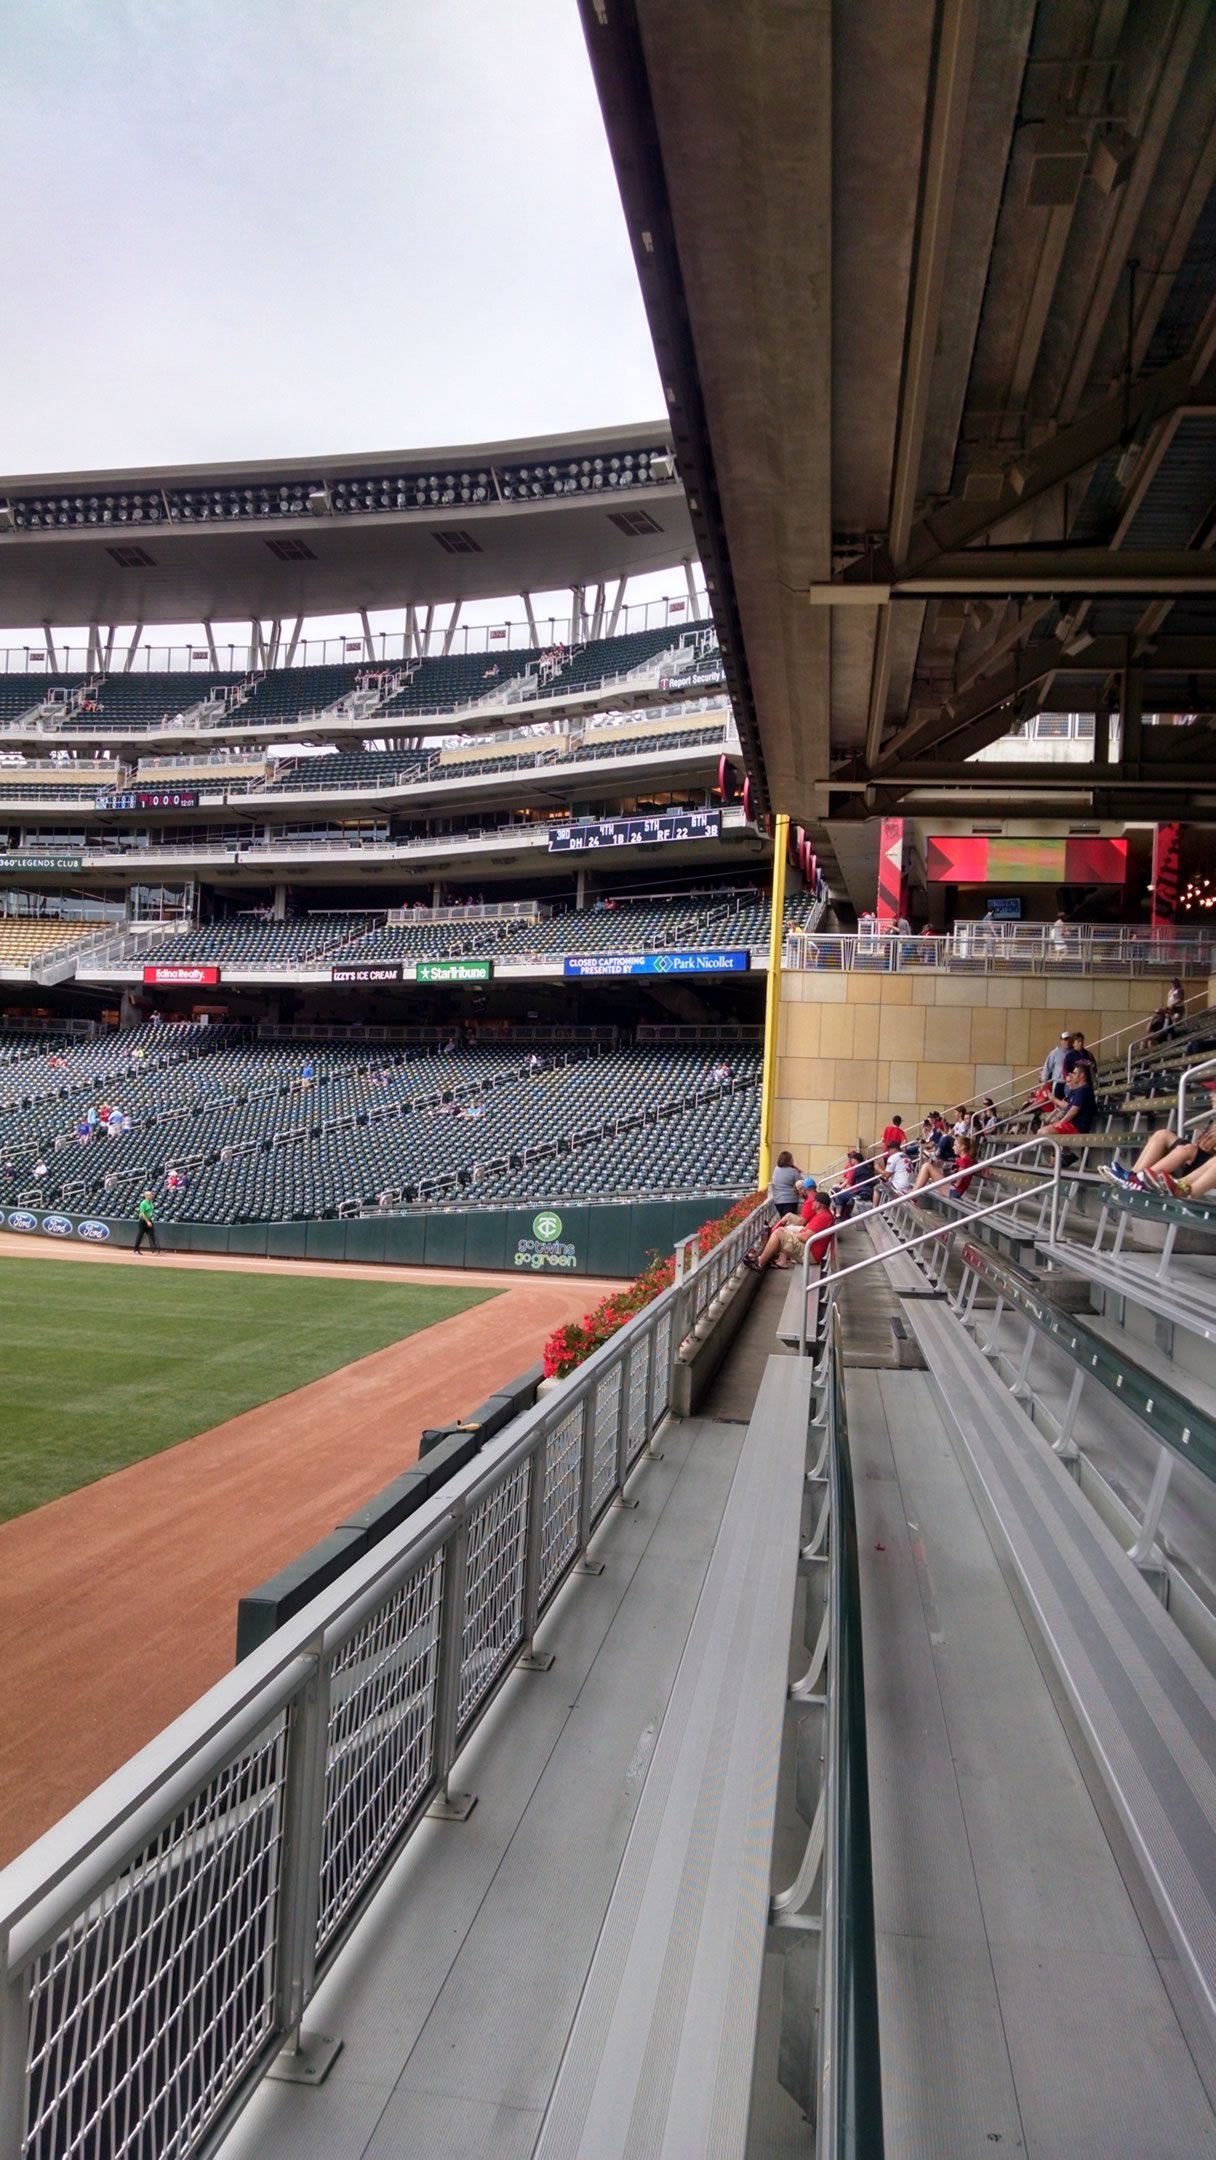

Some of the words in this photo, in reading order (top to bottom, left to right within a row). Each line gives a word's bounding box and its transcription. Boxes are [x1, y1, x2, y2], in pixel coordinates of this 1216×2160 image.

[669, 676, 691, 688] Report
[692, 672, 721, 684] Security
[153, 796, 159, 805] 0
[163, 796, 169, 805] 0
[173, 795, 179, 805] 0
[556, 828, 571, 840] 3RD
[600, 825, 614, 836] 4TH
[644, 820, 660, 831] 5TH
[691, 816, 707, 827] 6TH
[569, 838, 583, 848] DH
[588, 836, 600, 847] 24
[613, 834, 624, 844] 1B
[631, 832, 643, 843] 26
[657, 829, 670, 840] RF
[676, 828, 688, 839] 22
[705, 825, 718, 836] 3B
[569, 958, 598, 967] CLOSED
[598, 956, 645, 966] CAPTIONING
[674, 957, 694, 968] Park
[696, 956, 734, 968] Nicollet
[156, 969, 177, 978] Edina
[356, 970, 369, 980] ICE
[580, 965, 622, 975] PRESENTED
[623, 965, 633, 973] BY
